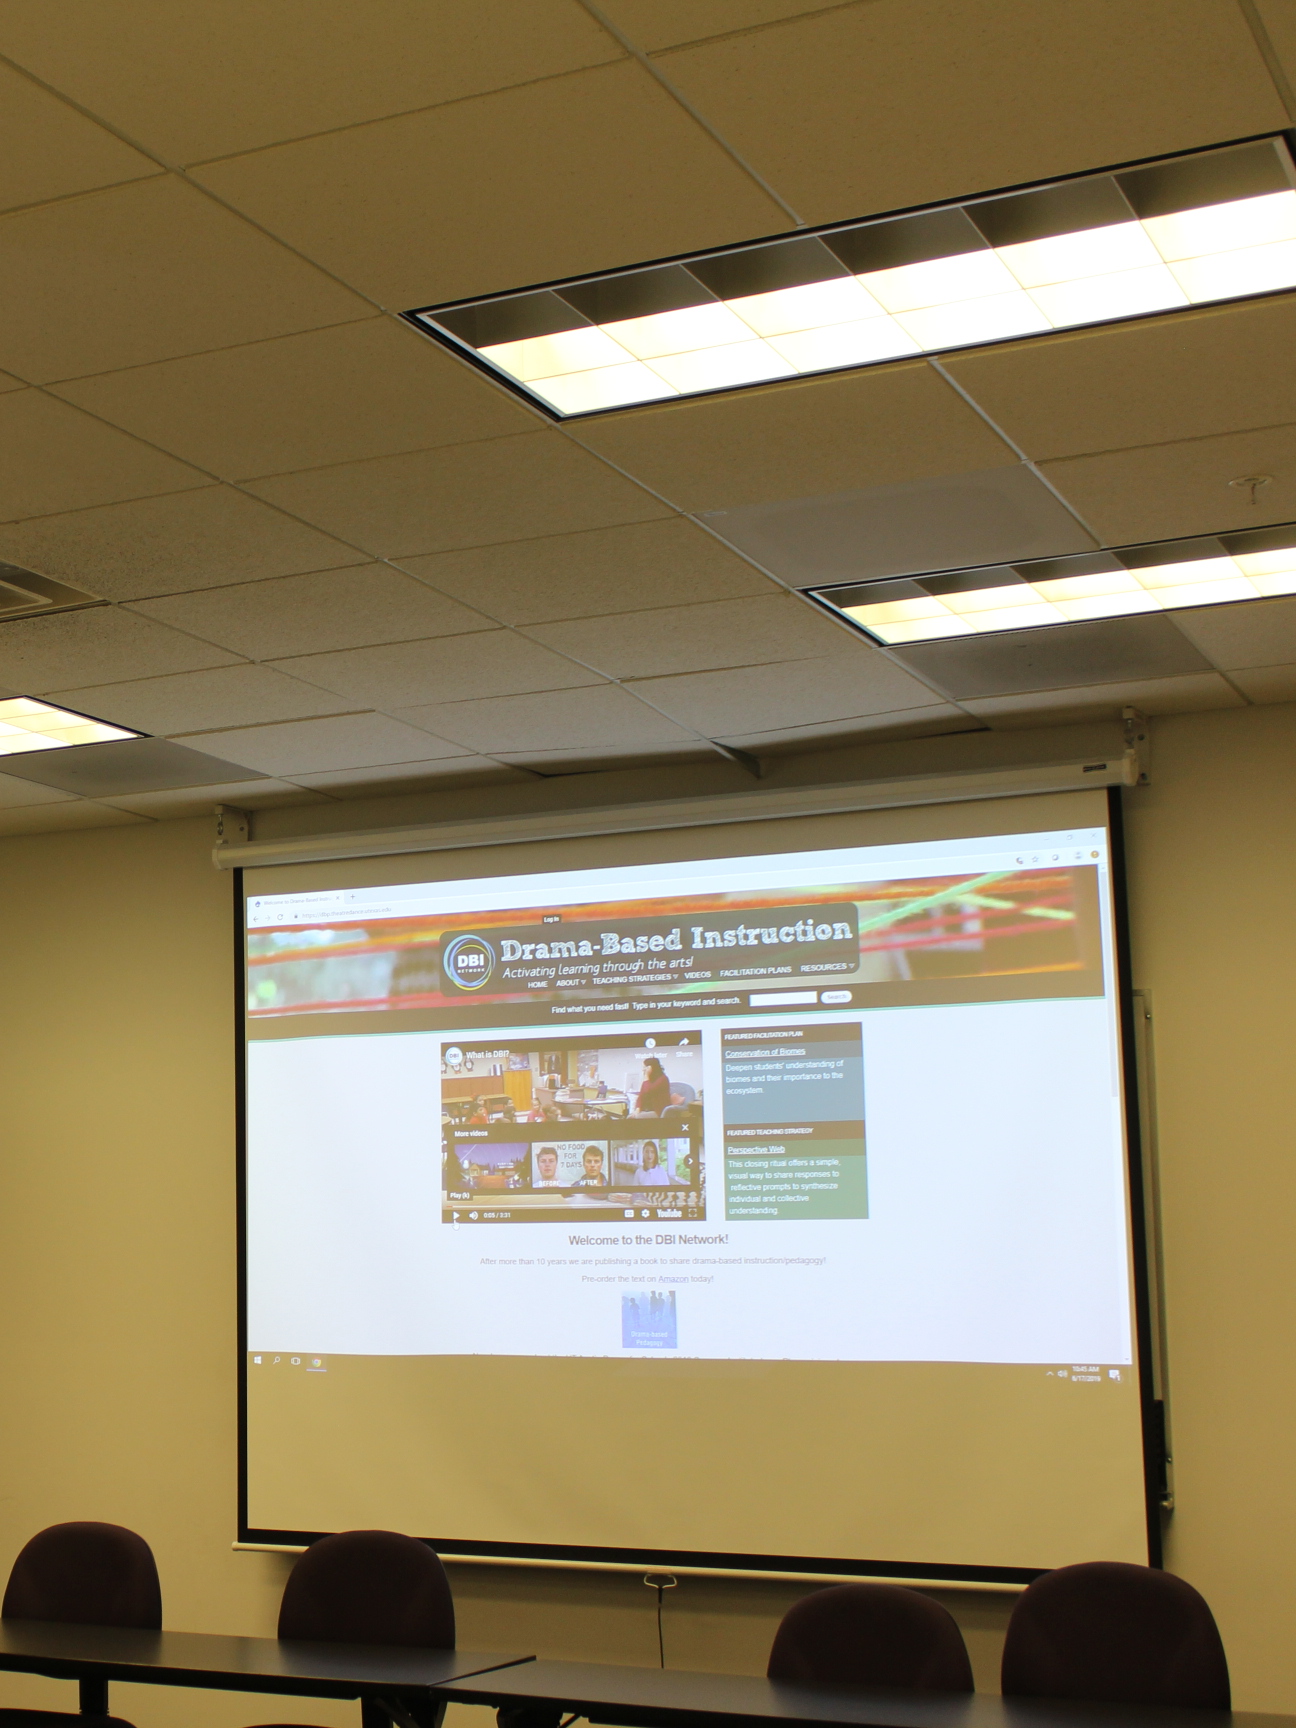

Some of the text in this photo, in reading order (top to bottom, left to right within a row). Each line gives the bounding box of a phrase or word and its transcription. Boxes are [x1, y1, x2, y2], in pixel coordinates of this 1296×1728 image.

[500, 919, 853, 962] Drama-Based Instruction
[457, 954, 484, 968] DBI
[502, 956, 694, 979] Activating learning through the arts!
[528, 963, 848, 989] HOME ABOUT TEACHING STRATEGIES VIDEOS FACILITATION PLANS RESOURCES
[552, 1006, 566, 1014] Find
[567, 1005, 583, 1013] what
[584, 1006, 596, 1014] you
[597, 1004, 613, 1012] need
[632, 1002, 648, 1011] Type
[657, 1001, 672, 1010] your
[673, 998, 701, 1009] keyword
[702, 998, 716, 1006] and
[716, 996, 742, 1005] search.
[724, 1030, 804, 1040] FEATURED FACILITATION PLAN
[466, 1050, 510, 1060] What is DBI?
[634, 1052, 654, 1060] Watch
[676, 1050, 693, 1058] Share
[725, 1047, 806, 1058] Conservation of Biomes
[726, 1064, 752, 1073] Deepen
[786, 1060, 834, 1070] understanding
[836, 1060, 844, 1068] of
[726, 1076, 750, 1084] biomes
[752, 1074, 766, 1082] and
[766, 1074, 782, 1082] their
[784, 1073, 822, 1082] importance
[823, 1072, 830, 1080] to
[726, 1086, 764, 1096] ecosystem.
[727, 1127, 814, 1136] FEATURED TEACHING STRATEGY
[728, 1146, 786, 1155] Perspective Web
[728, 1160, 743, 1168] This
[744, 1160, 769, 1169] closing
[770, 1159, 787, 1167] ritual
[788, 1158, 808, 1167] offers
[728, 1170, 839, 1181] visual way to share responses to
[730, 1182, 838, 1192] reflective prompts to synthesize
[450, 1192, 470, 1200] Play (k)
[729, 1194, 810, 1203] individual and collective
[656, 1209, 682, 1218] YouTube
[568, 1234, 729, 1246] Welcome to the DBI Network!
[547, 1259, 567, 1267] years
[594, 1257, 632, 1266] publishing
[640, 1257, 658, 1265] book
[669, 1257, 690, 1265] share
[692, 1257, 742, 1265] drama-based
[743, 1256, 826, 1266] instruction/pedagogy!
[582, 1275, 616, 1283] Pre-order
[617, 1275, 630, 1283] the
[658, 1275, 689, 1283] Amazon
[691, 1275, 714, 1284] today!
